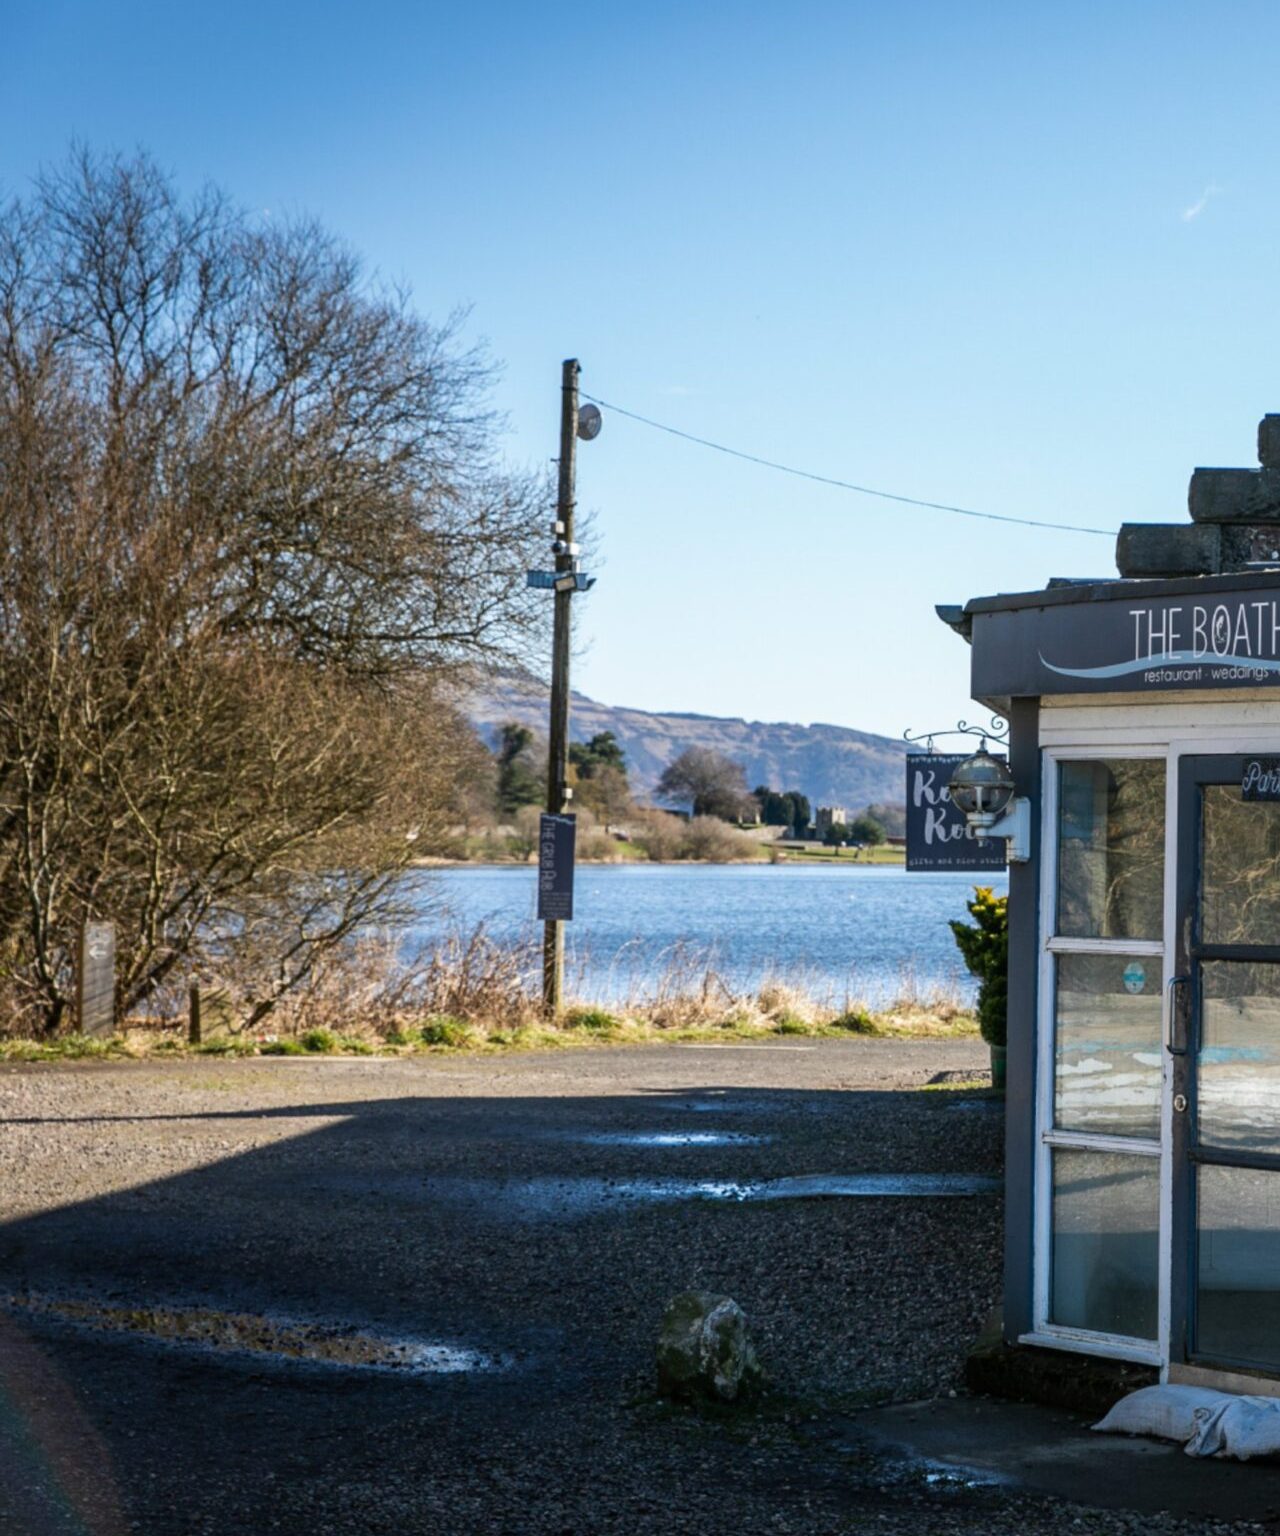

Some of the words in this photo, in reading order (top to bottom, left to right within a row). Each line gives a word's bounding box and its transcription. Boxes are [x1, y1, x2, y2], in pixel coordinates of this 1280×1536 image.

[1129, 607, 1182, 661] THE
[1144, 668, 1202, 683] restaurant
[1212, 665, 1269, 681] weddings
